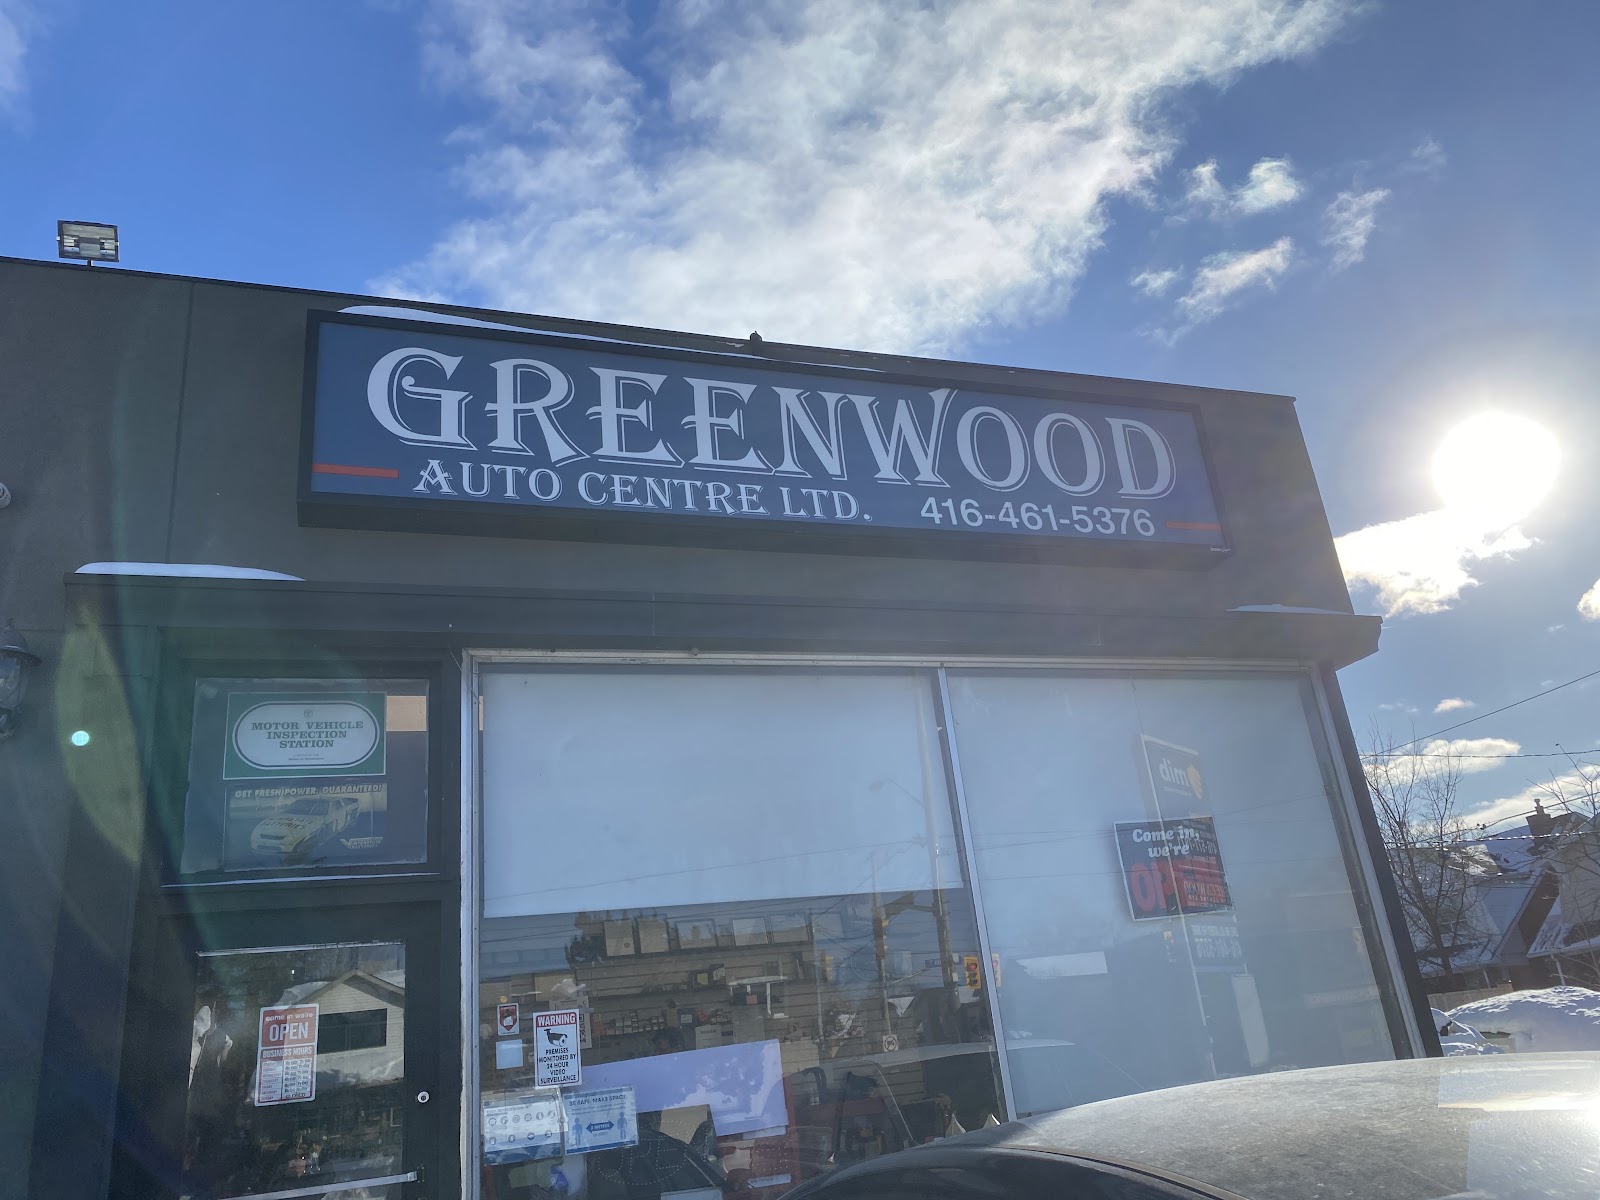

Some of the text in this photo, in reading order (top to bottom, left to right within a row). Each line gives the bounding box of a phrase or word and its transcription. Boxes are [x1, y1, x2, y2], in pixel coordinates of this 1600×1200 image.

[367, 347, 1176, 499] GREENWOOD
[412, 459, 873, 522] AUTO CENTRE LTD.
[920, 497, 1155, 537] 416-461-5376
[251, 721, 364, 731] MOTOR VEHICLE
[266, 730, 347, 740] INSPECTION
[279, 740, 334, 749] STATION
[235, 790, 252, 798] GET
[254, 788, 282, 797] FRESH
[322, 784, 383, 795] GUARANTEED!
[1132, 827, 1174, 843] Come
[1178, 825, 1200, 840] in,
[1148, 842, 1190, 859] we're
[265, 1013, 285, 1022] come
[537, 1013, 577, 1027] WARNING
[269, 1022, 308, 1042] OPEN
[262, 1046, 313, 1059] BUSINESS HOURS
[539, 1053, 576, 1063] MONITORED BY
[540, 1075, 576, 1085] SURVEILLANCE
[592, 1096, 608, 1104] MAKE
